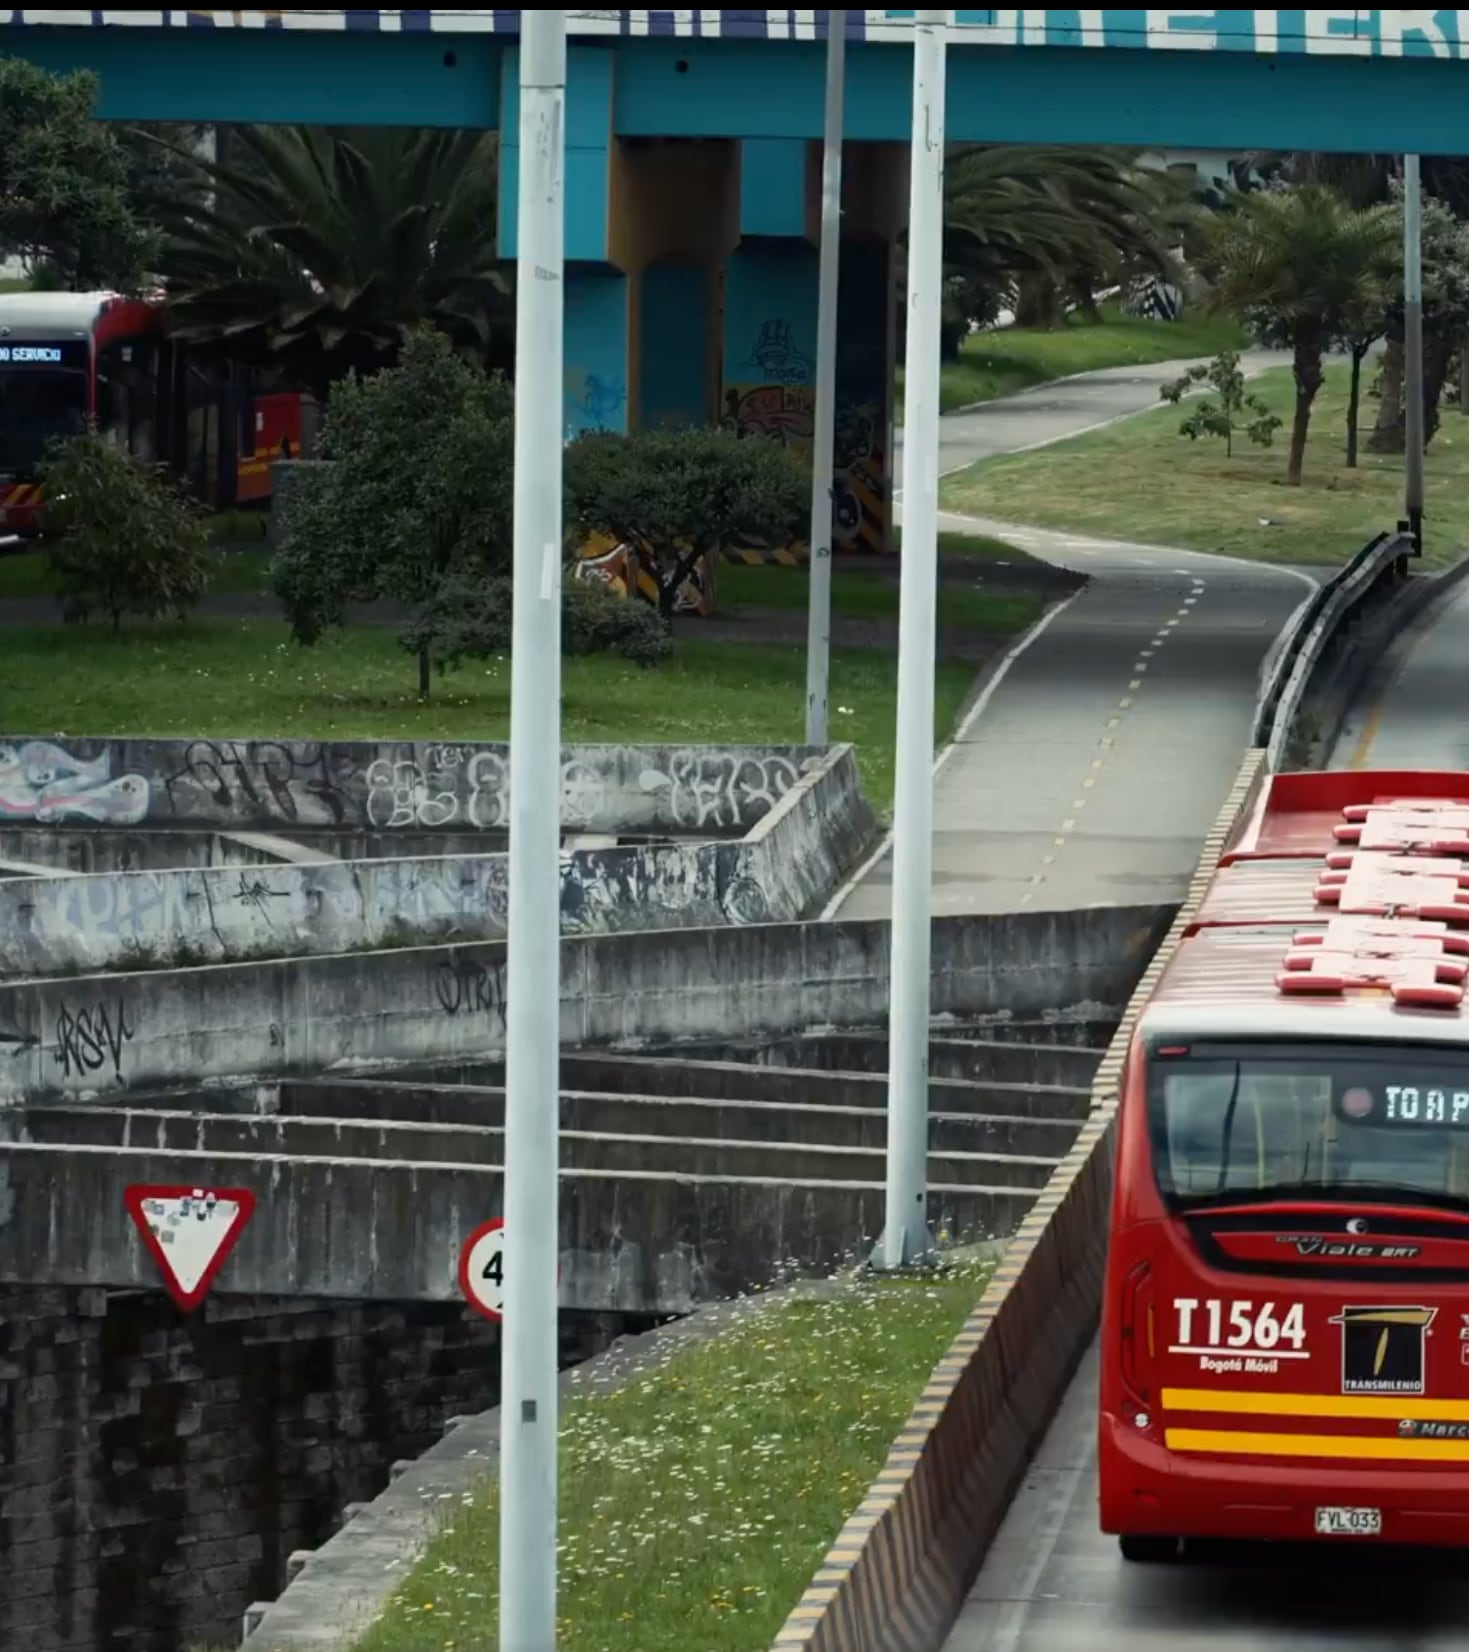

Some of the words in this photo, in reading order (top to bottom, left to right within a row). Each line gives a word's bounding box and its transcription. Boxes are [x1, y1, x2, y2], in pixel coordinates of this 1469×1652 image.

[1296, 1242, 1373, 1256] Viale
[1173, 1298, 1306, 1349] T1564
[1200, 1355, 1242, 1373] Bogotá
[1245, 1358, 1278, 1374] Móvil
[1345, 1379, 1421, 1390] TRANSMILENIO
